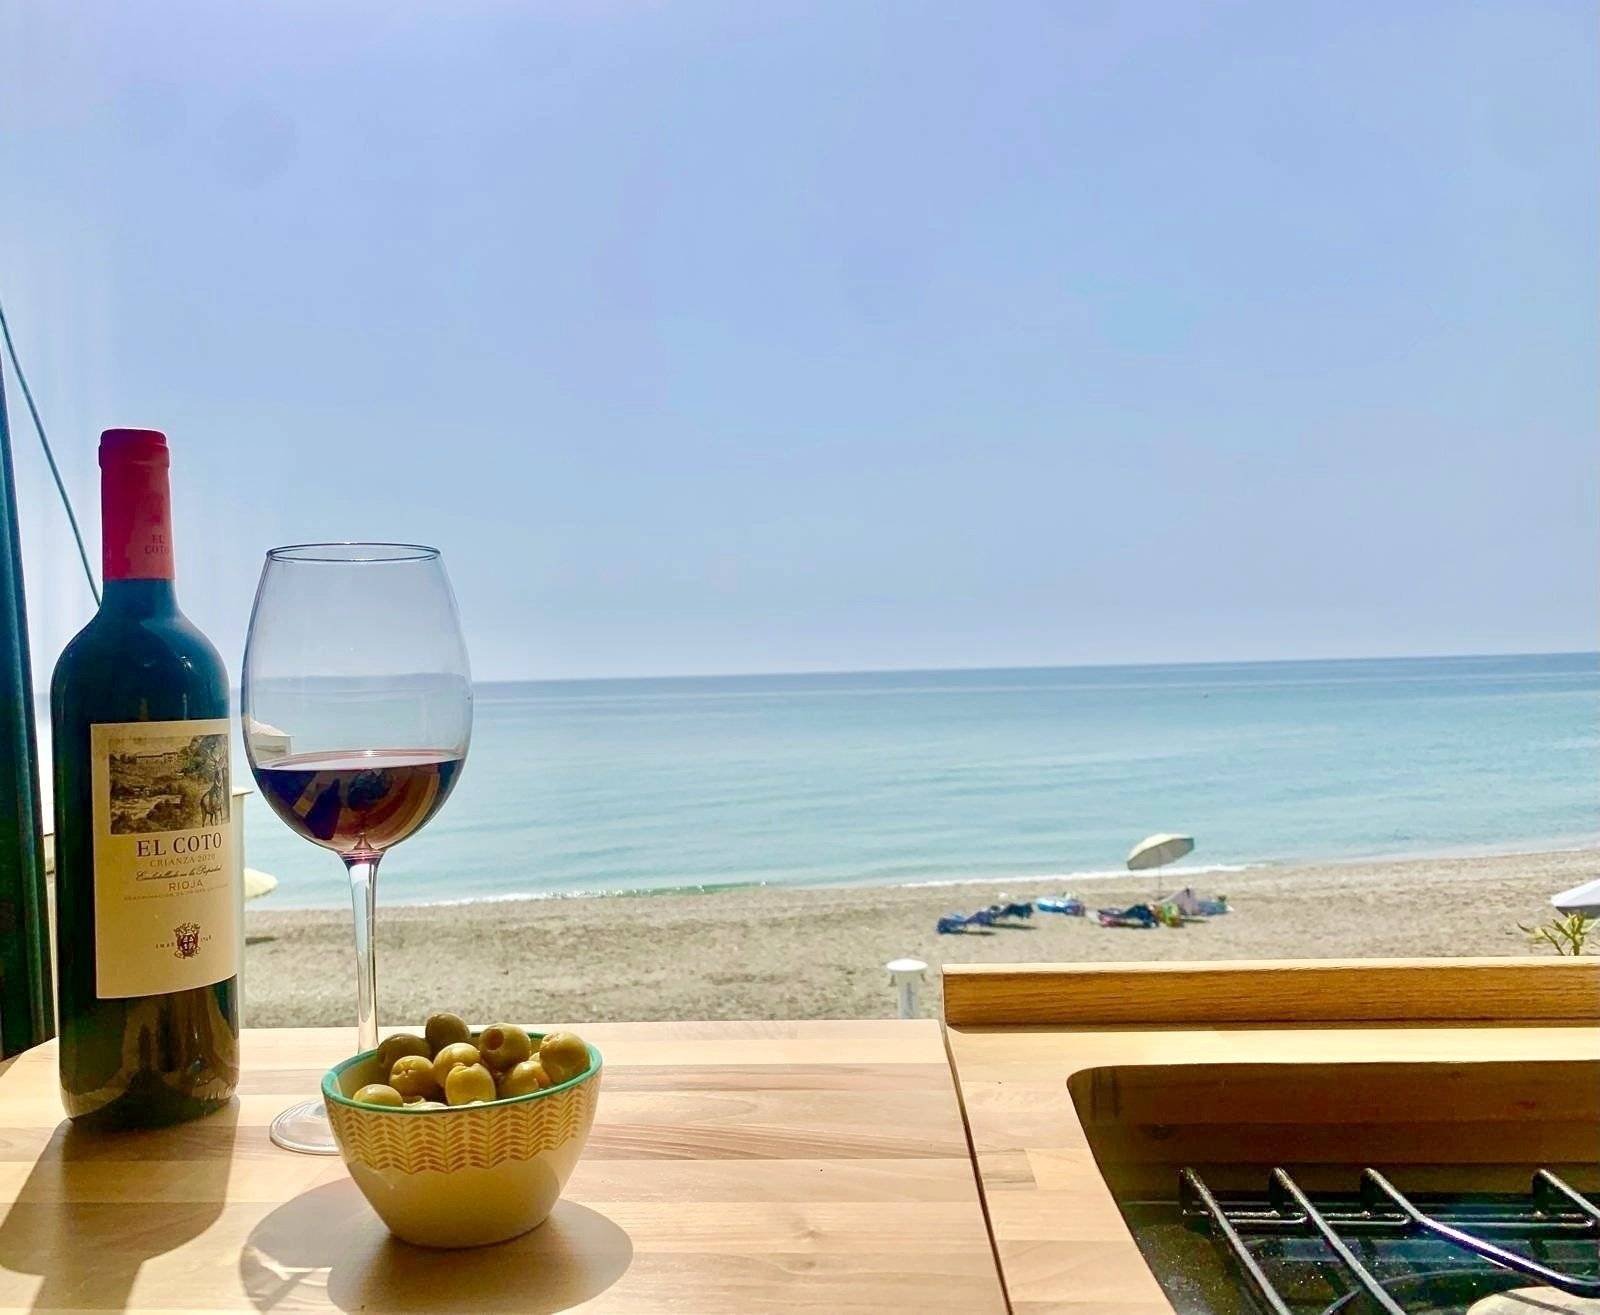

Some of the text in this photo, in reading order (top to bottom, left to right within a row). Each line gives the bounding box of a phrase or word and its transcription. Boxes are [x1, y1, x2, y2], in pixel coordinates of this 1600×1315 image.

[152, 534, 165, 544] EL
[137, 832, 222, 857] EL COTO
[150, 856, 196, 868] CRIANZA
[168, 880, 204, 892] RIOJA
